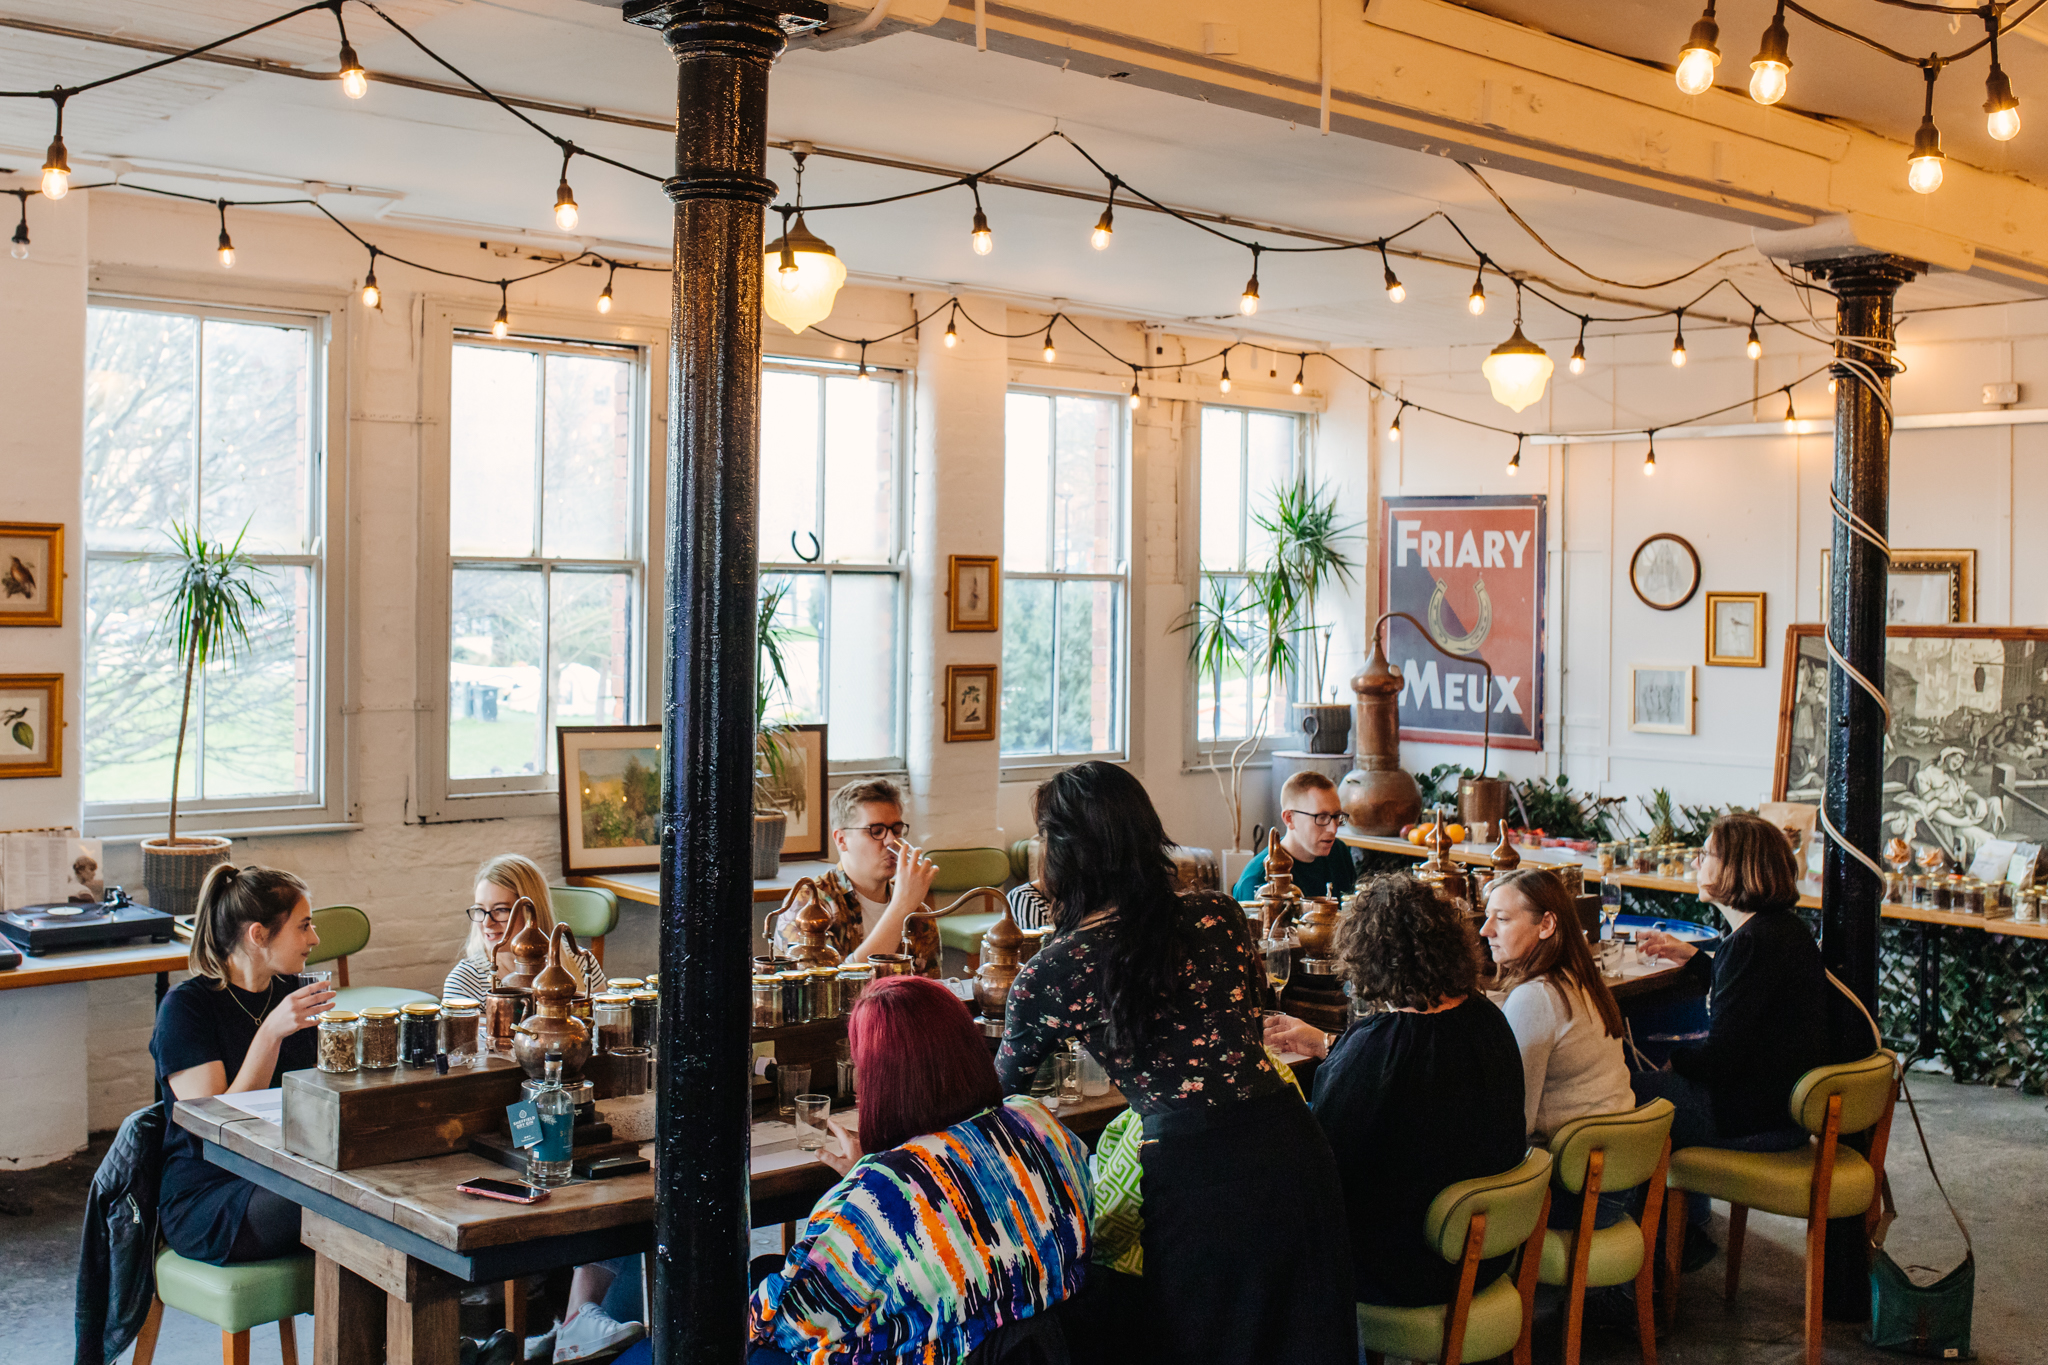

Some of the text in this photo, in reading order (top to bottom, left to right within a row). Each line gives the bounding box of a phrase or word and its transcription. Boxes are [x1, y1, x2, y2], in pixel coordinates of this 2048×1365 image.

[1397, 520, 1531, 568] FRIARY
[1399, 658, 1523, 714] MEUX
[513, 1116, 535, 1126] SHEFFIELD
